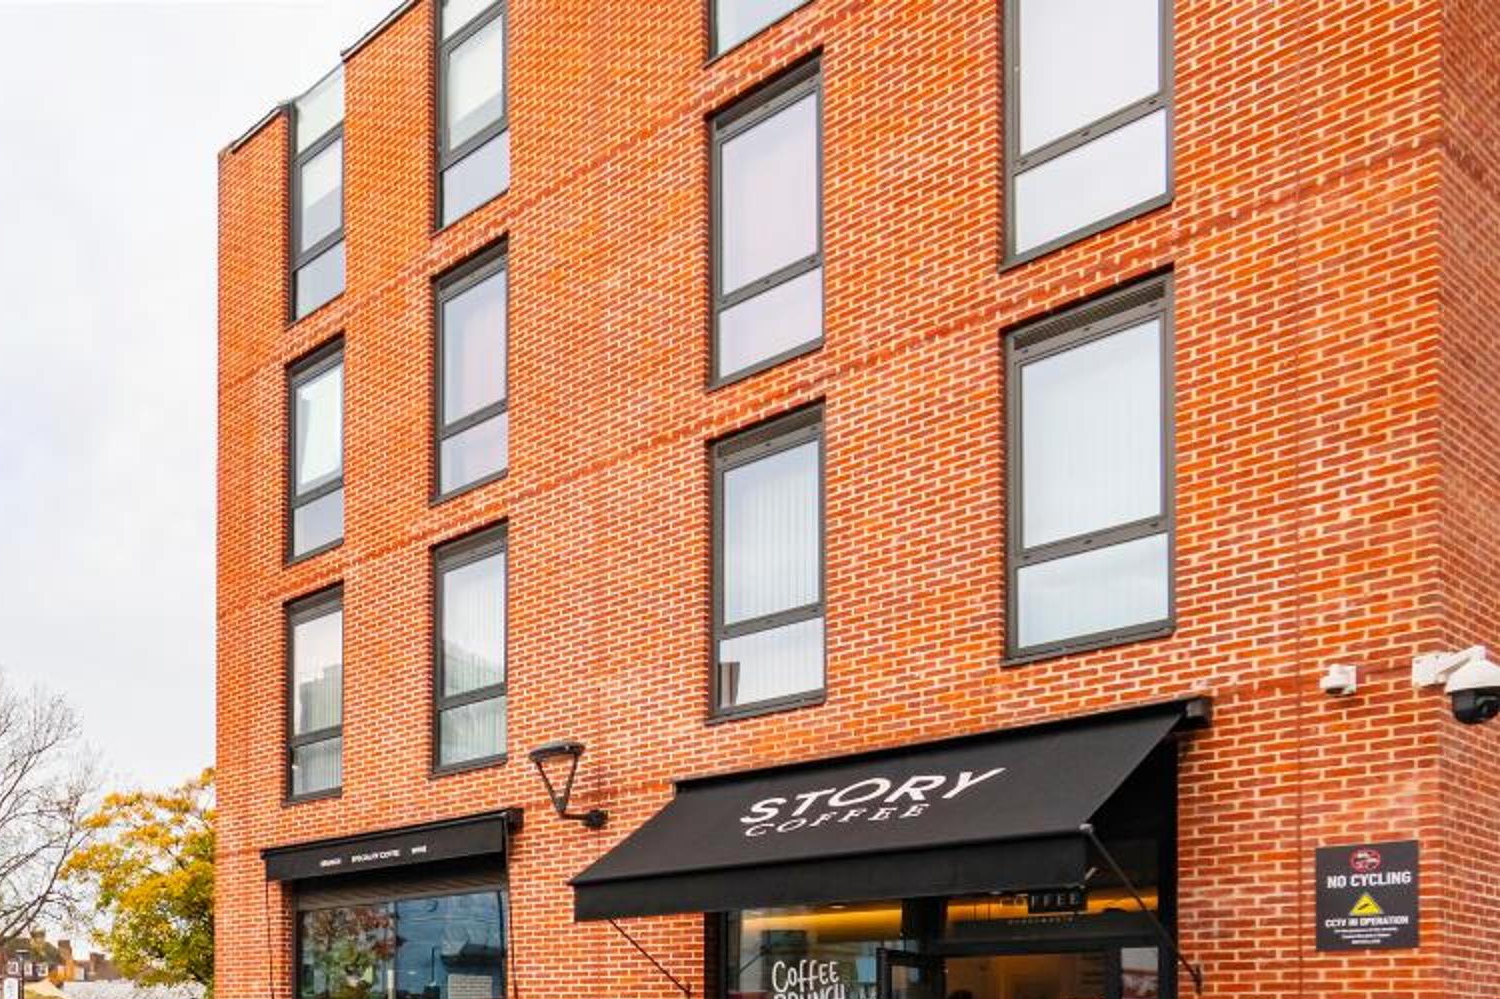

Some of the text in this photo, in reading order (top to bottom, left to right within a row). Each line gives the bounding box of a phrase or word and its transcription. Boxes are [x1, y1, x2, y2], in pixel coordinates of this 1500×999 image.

[740, 767, 1006, 824] STORY
[745, 803, 930, 837] COFFEE
[1327, 871, 1412, 888] NO CYCLING
